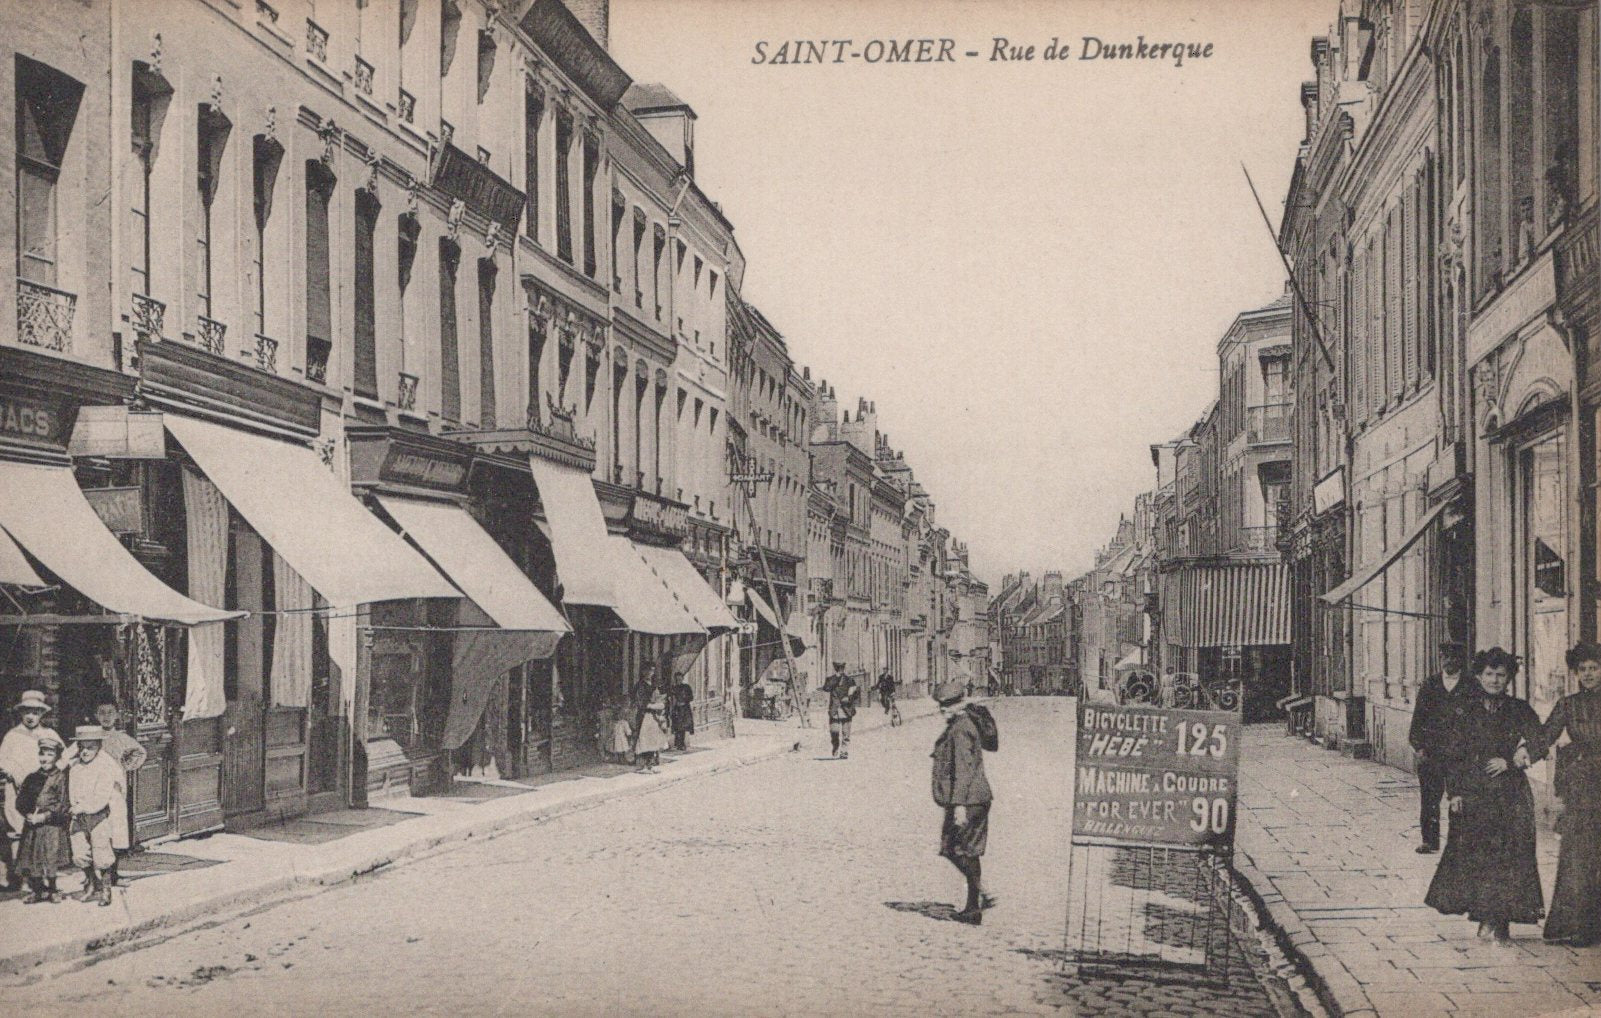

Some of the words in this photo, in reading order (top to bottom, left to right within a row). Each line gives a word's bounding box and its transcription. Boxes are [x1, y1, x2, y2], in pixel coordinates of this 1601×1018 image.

[0, 404, 50, 436] ACS
[1084, 709, 1169, 733] BICYCLETTE
[1174, 721, 1228, 758] 125
[1078, 767, 1151, 794] MACHINE
[1163, 772, 1229, 792] COUDRE
[1189, 796, 1229, 835] 90
